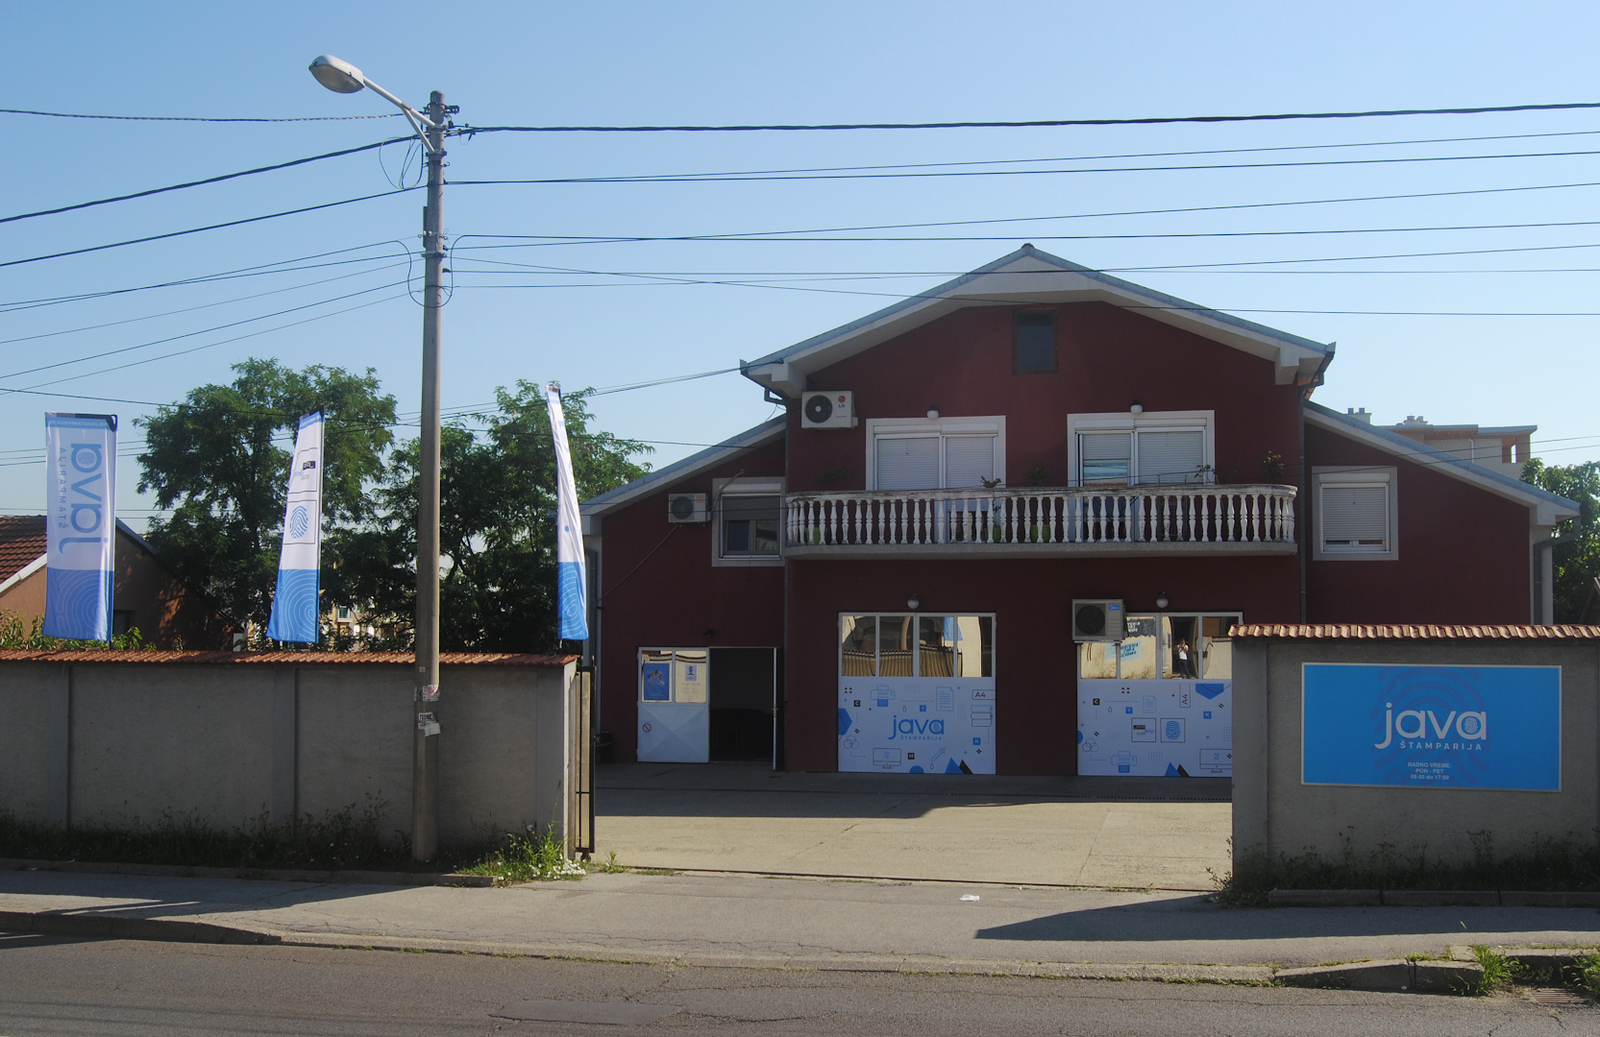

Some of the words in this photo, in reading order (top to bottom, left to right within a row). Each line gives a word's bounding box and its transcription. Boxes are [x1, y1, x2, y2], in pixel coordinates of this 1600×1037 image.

[1181, 693, 1188, 705] A4
[888, 715, 945, 740] java
[1374, 702, 1487, 750] java
[1400, 740, 1482, 750] ŠTAMPARIJA
